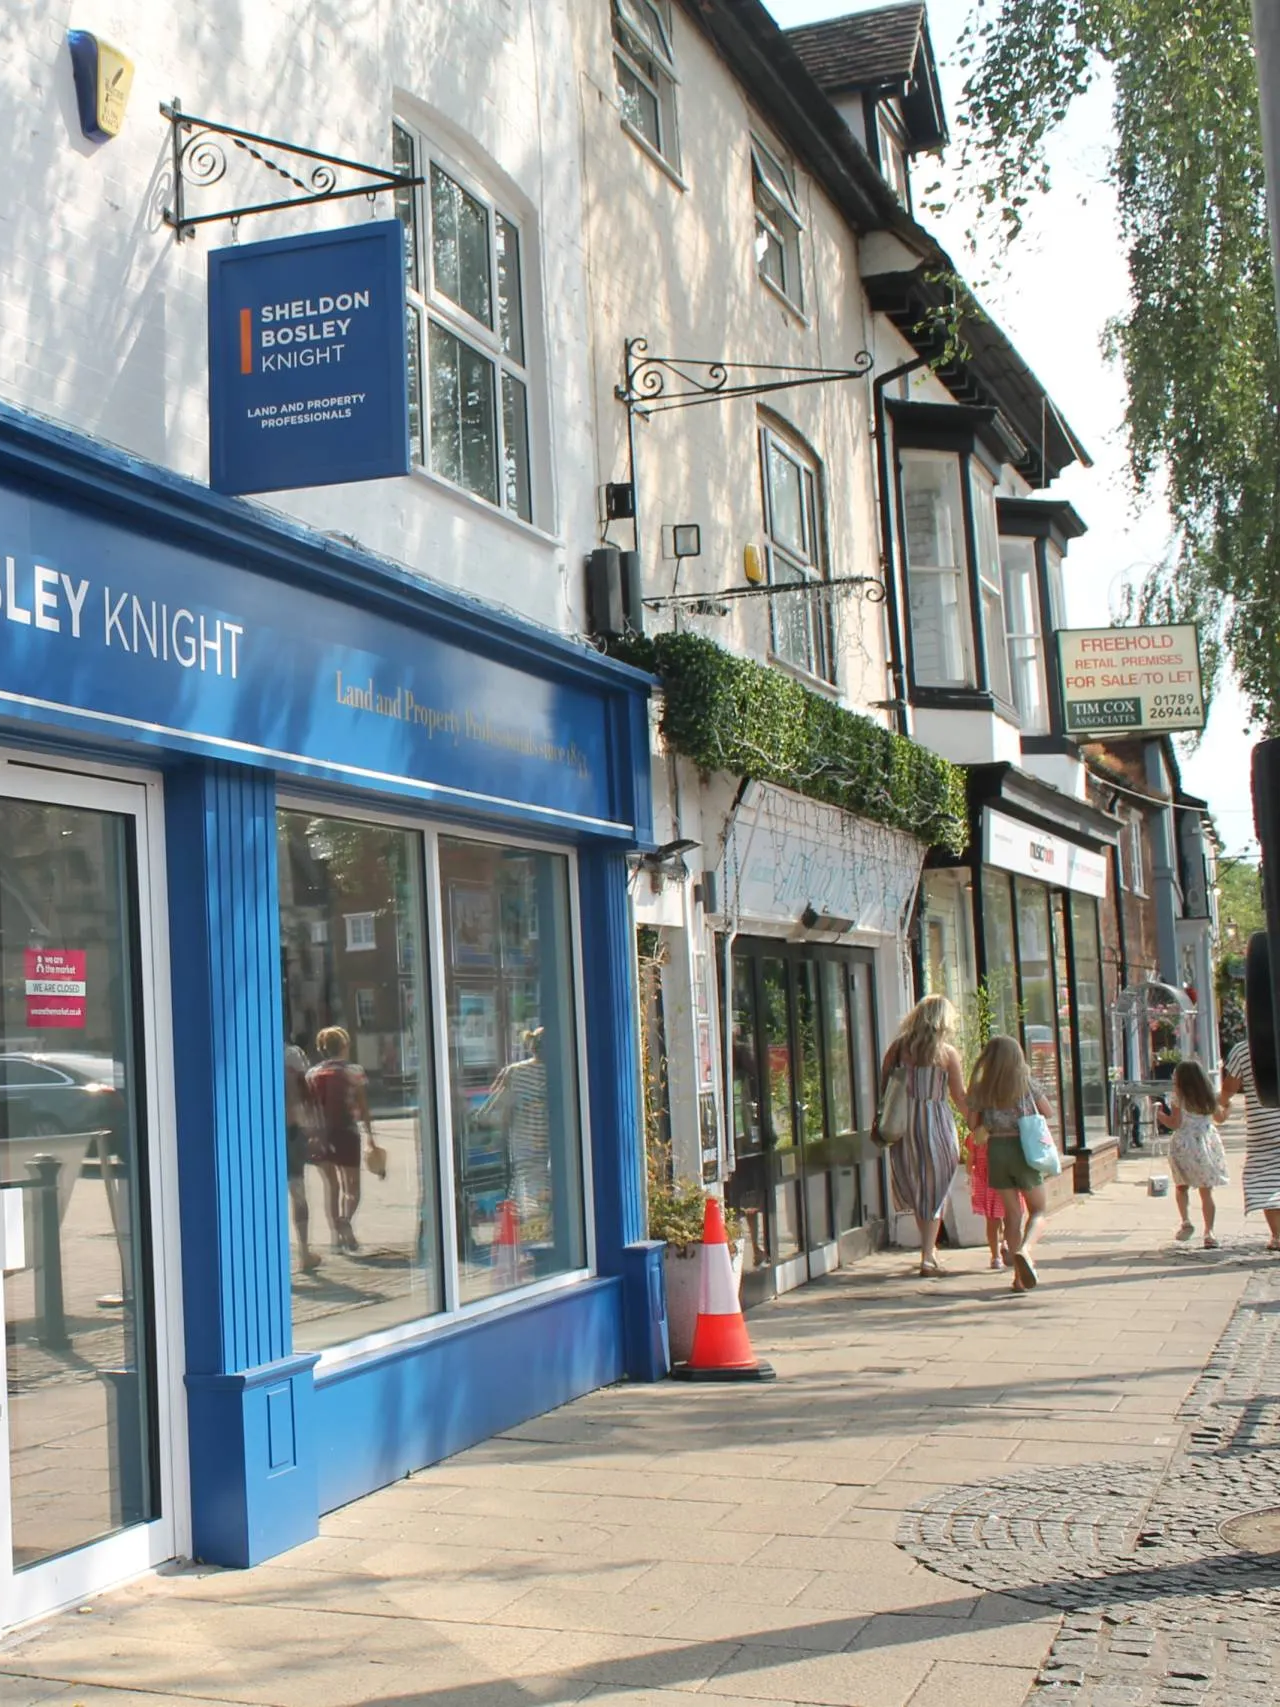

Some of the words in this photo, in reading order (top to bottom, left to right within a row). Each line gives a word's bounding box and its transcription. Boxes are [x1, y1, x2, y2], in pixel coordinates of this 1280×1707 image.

[261, 290, 369, 323] SHELDON
[261, 318, 351, 347] BOSLEY
[261, 344, 345, 373] KNIGHT
[247, 406, 278, 418] LAND
[280, 402, 304, 414] AND
[307, 394, 366, 411] PROPERTY
[261, 408, 352, 428] PROFESSIONALS
[104, 586, 244, 679] KNIGHT
[1080, 634, 1174, 652] FREEHOLD
[1075, 658, 1117, 669] RETAIL
[1122, 654, 1183, 667] PREMISES
[1066, 676, 1095, 688] FOR
[1168, 671, 1194, 683] LET
[335, 670, 373, 710] Land
[376, 686, 402, 720] and
[404, 689, 460, 746] Property
[1072, 703, 1099, 715] TIM
[1103, 700, 1135, 713] COX
[1154, 694, 1194, 706] 01789
[1074, 715, 1137, 726] ASSOCIATES
[1150, 706, 1200, 719] 269444
[56, 964, 76, 974] market
[33, 983, 43, 992] WE
[44, 983, 56, 992] ARE
[56, 983, 80, 993] CLOSED
